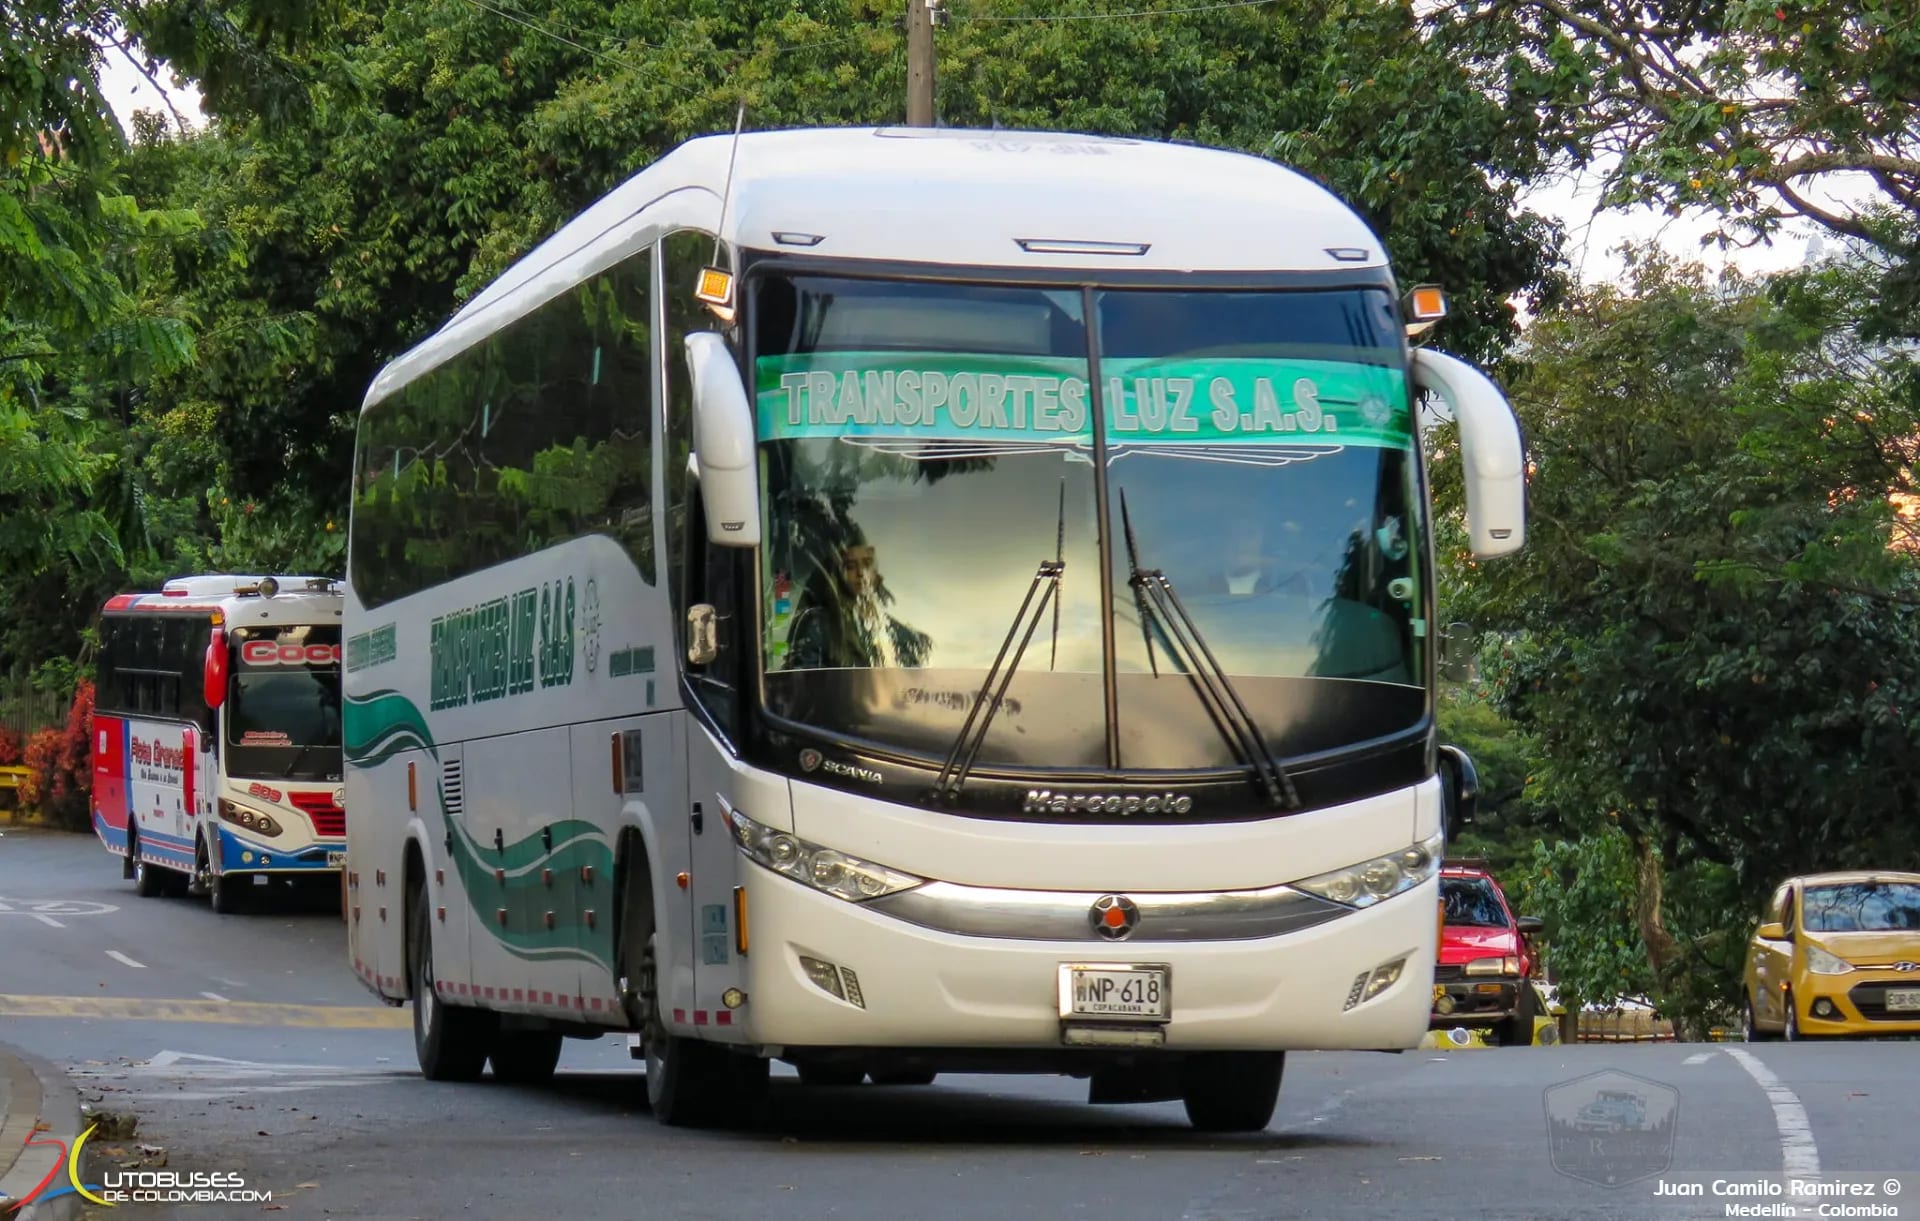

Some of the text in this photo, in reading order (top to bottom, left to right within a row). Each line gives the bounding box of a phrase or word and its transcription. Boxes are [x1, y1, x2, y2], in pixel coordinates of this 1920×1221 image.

[781, 370, 1337, 432] TRANSPORTES LUZ S.A.S.
[823, 760, 883, 784] SCANIA
[1023, 790, 1192, 815] Marcopolo
